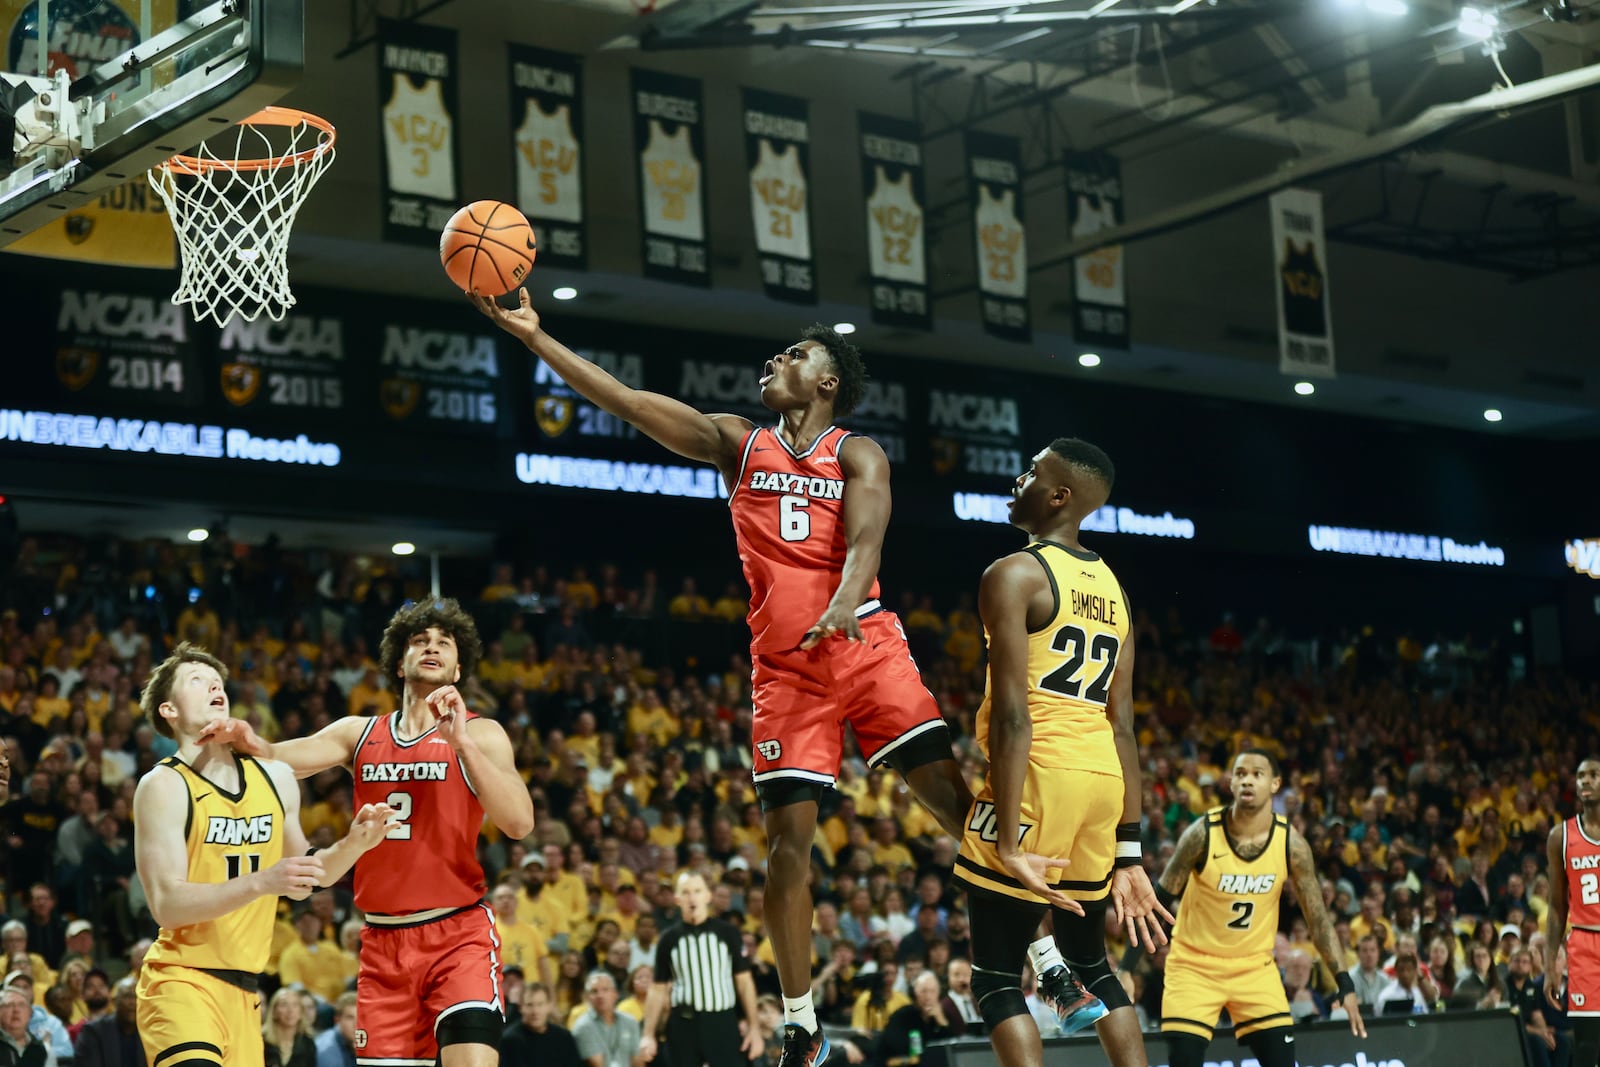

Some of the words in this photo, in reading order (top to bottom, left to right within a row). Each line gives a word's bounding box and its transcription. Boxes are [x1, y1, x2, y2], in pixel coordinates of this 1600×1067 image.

[389, 114, 447, 151] VCU
[411, 147, 430, 177] 3
[517, 139, 577, 175] VCU
[539, 172, 558, 204] 5
[645, 159, 697, 193] VCU
[753, 178, 804, 213] VCU
[769, 210, 793, 239] 21
[871, 206, 921, 240] VCU
[980, 223, 1022, 255] VCU
[883, 237, 911, 265] 22
[989, 253, 1016, 283] 23
[57, 290, 187, 343] NCAA
[219, 311, 345, 360] NCAA
[380, 325, 499, 378] NCAA
[108, 356, 184, 393] 2014
[268, 374, 343, 408] 2015
[928, 388, 1020, 437] NCAA
[227, 429, 340, 466] Resolve
[750, 471, 845, 500] DAYTON
[779, 494, 811, 542] 6
[1071, 589, 1117, 626] BAMISILE
[1037, 623, 1121, 707] 22
[361, 761, 449, 783] DAYTON
[204, 813, 273, 846] RAMS
[385, 791, 413, 840] 2
[1217, 873, 1277, 896] RAMS
[1226, 901, 1254, 931] 2
